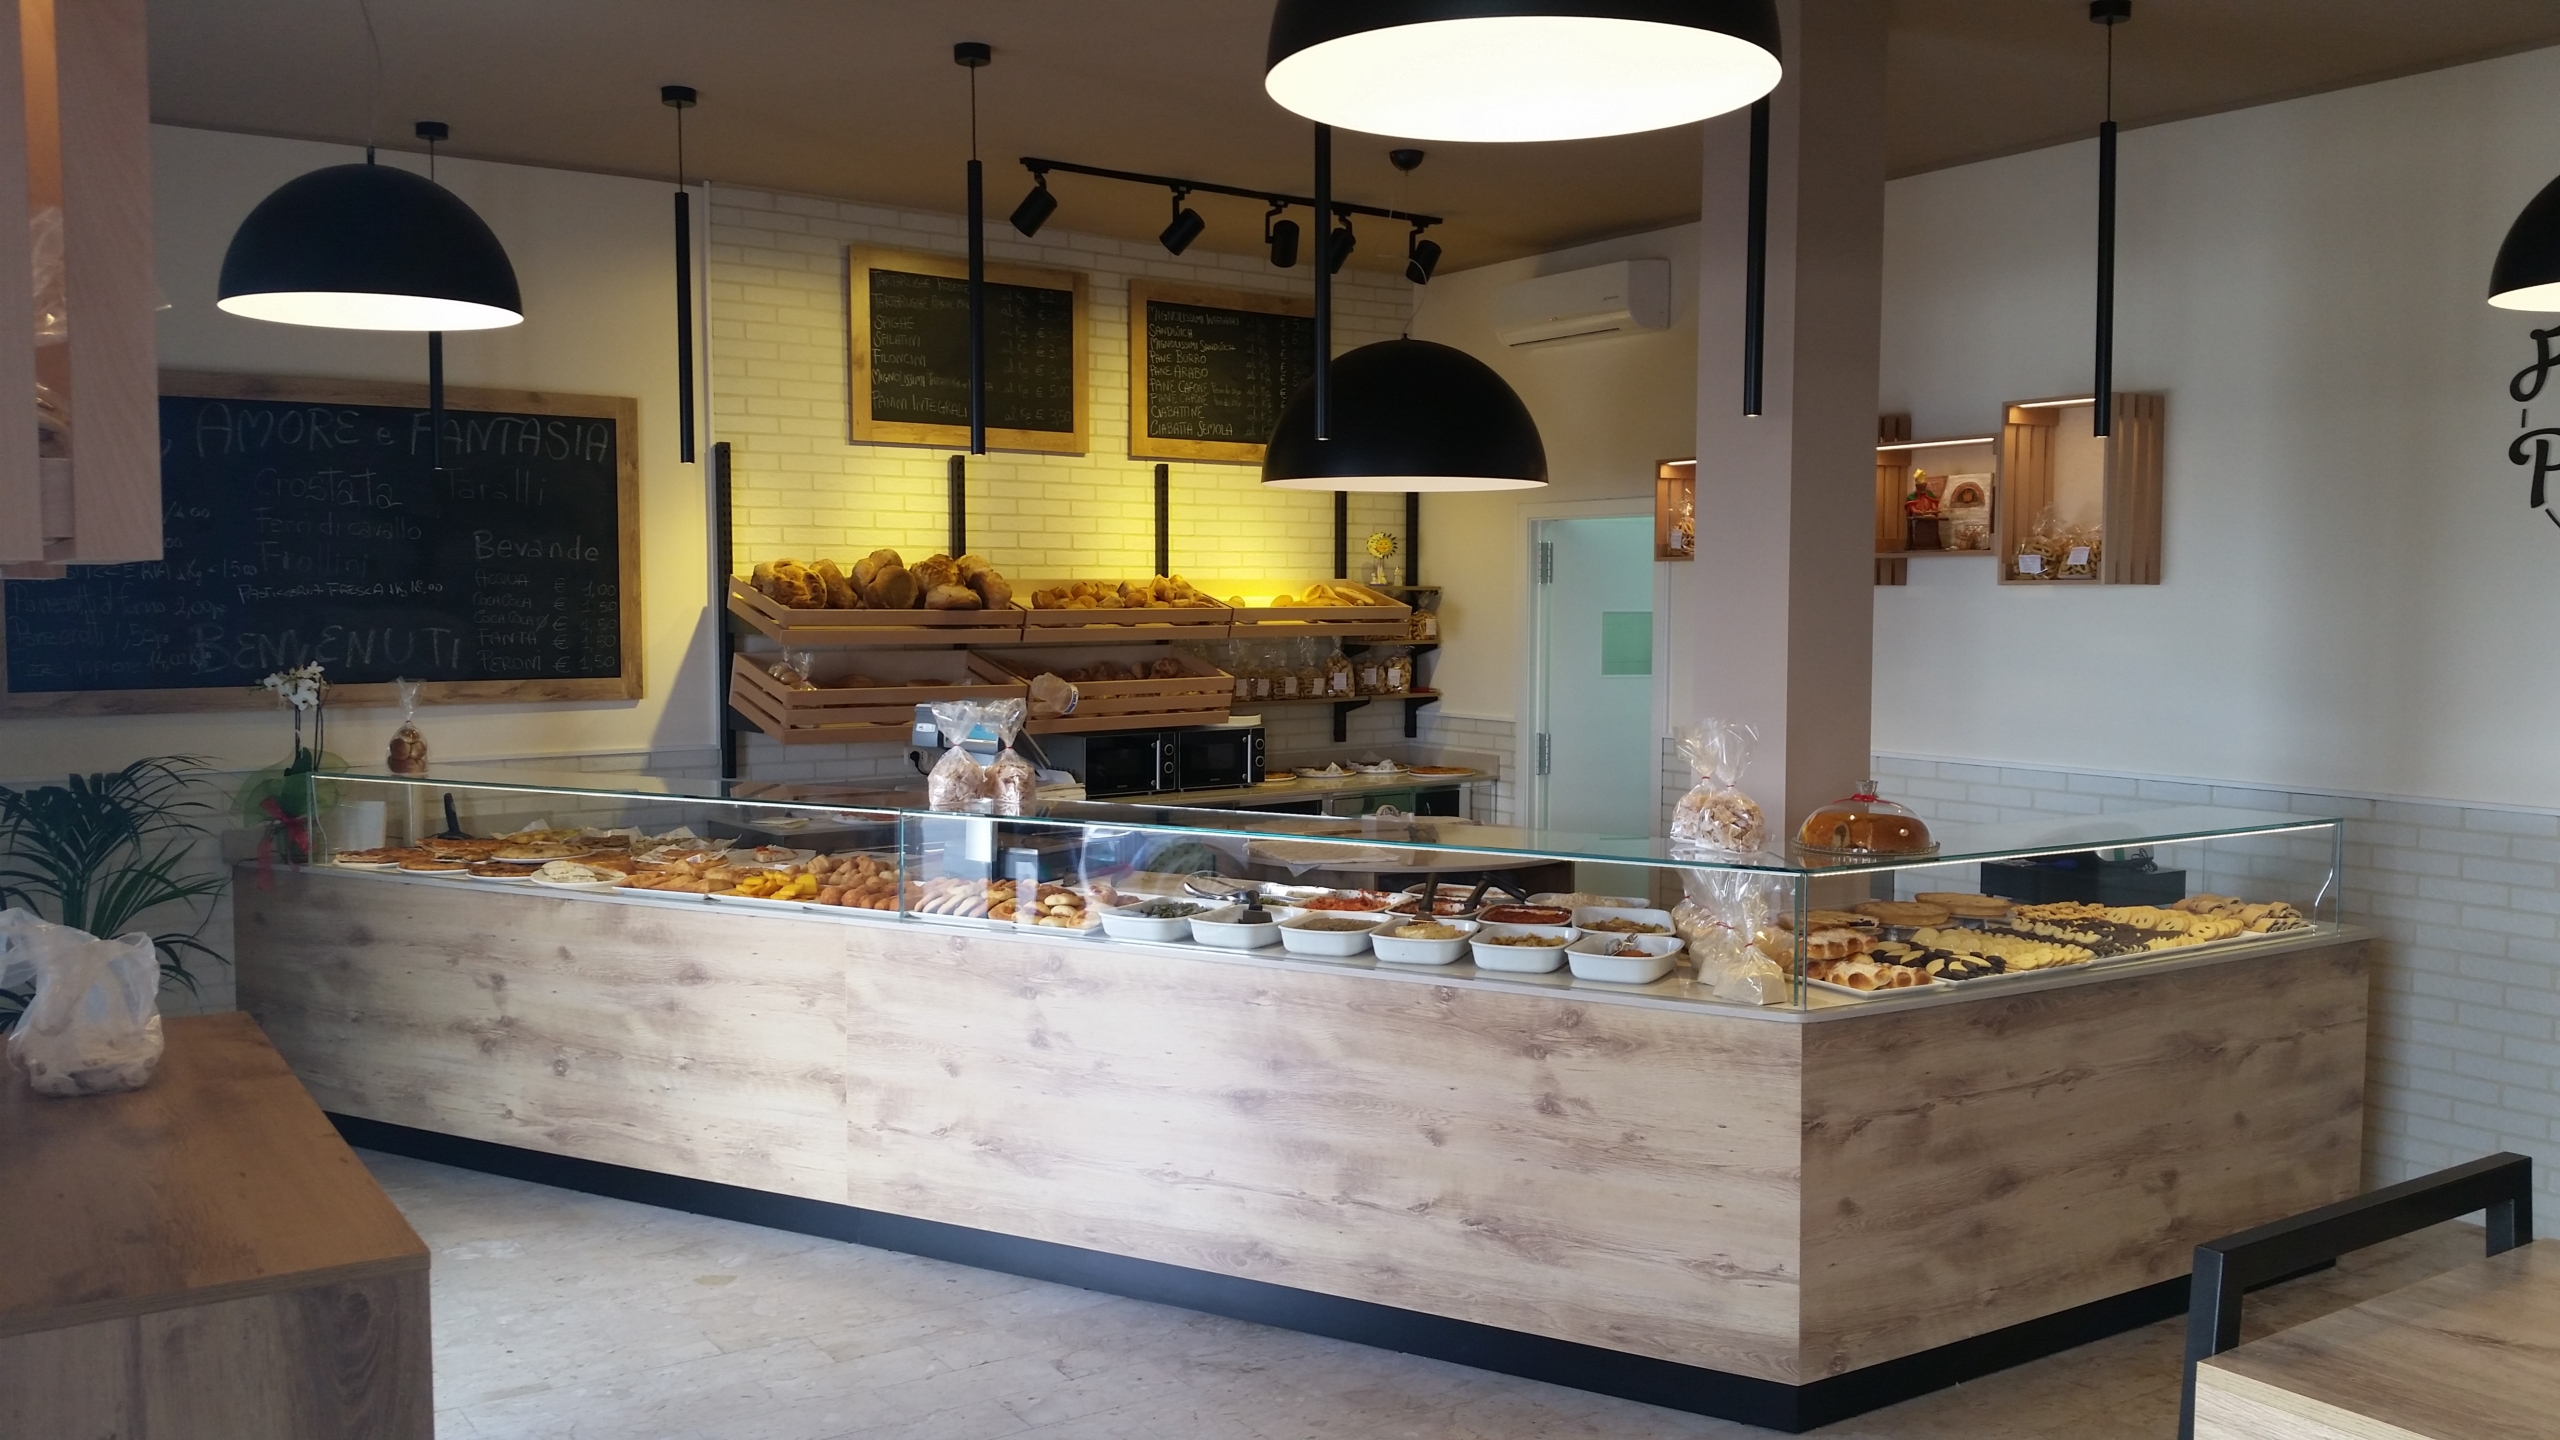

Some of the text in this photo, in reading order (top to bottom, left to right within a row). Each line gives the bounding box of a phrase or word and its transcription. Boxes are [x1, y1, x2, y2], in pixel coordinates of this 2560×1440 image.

[873, 314, 915, 330] SPIGHE
[1148, 323, 1193, 338] SANDWICH
[1149, 349, 1172, 364] PANE
[1175, 349, 1207, 364] BURRO
[1149, 364, 1173, 377] PANE
[1174, 364, 1209, 379] ARABO
[1149, 378, 1176, 393] PANE
[1178, 380, 1209, 394] CAFONE
[912, 394, 967, 418] INTEGRALI
[1149, 393, 1177, 405] PANE
[1150, 405, 1205, 419] CIABATTINE
[196, 402, 608, 463] AMORE e FANTASIA
[1149, 419, 1193, 436] CIABATTA
[1197, 420, 1233, 437] SEMOLA
[254, 467, 403, 508] Crostata
[433, 467, 547, 506] Taralli
[252, 507, 422, 540] Ferri di cavallo
[473, 529, 599, 561] Bevande
[252, 540, 369, 578] Frollini
[326, 581, 384, 597] FRESCA
[474, 568, 616, 598] ACQUA € 1,00
[553, 597, 567, 611] €
[552, 616, 569, 631] €
[188, 622, 461, 673] BENVENUTI
[477, 628, 616, 653] FANTA € 1,50
[476, 649, 616, 673] PERONI € 1,50
